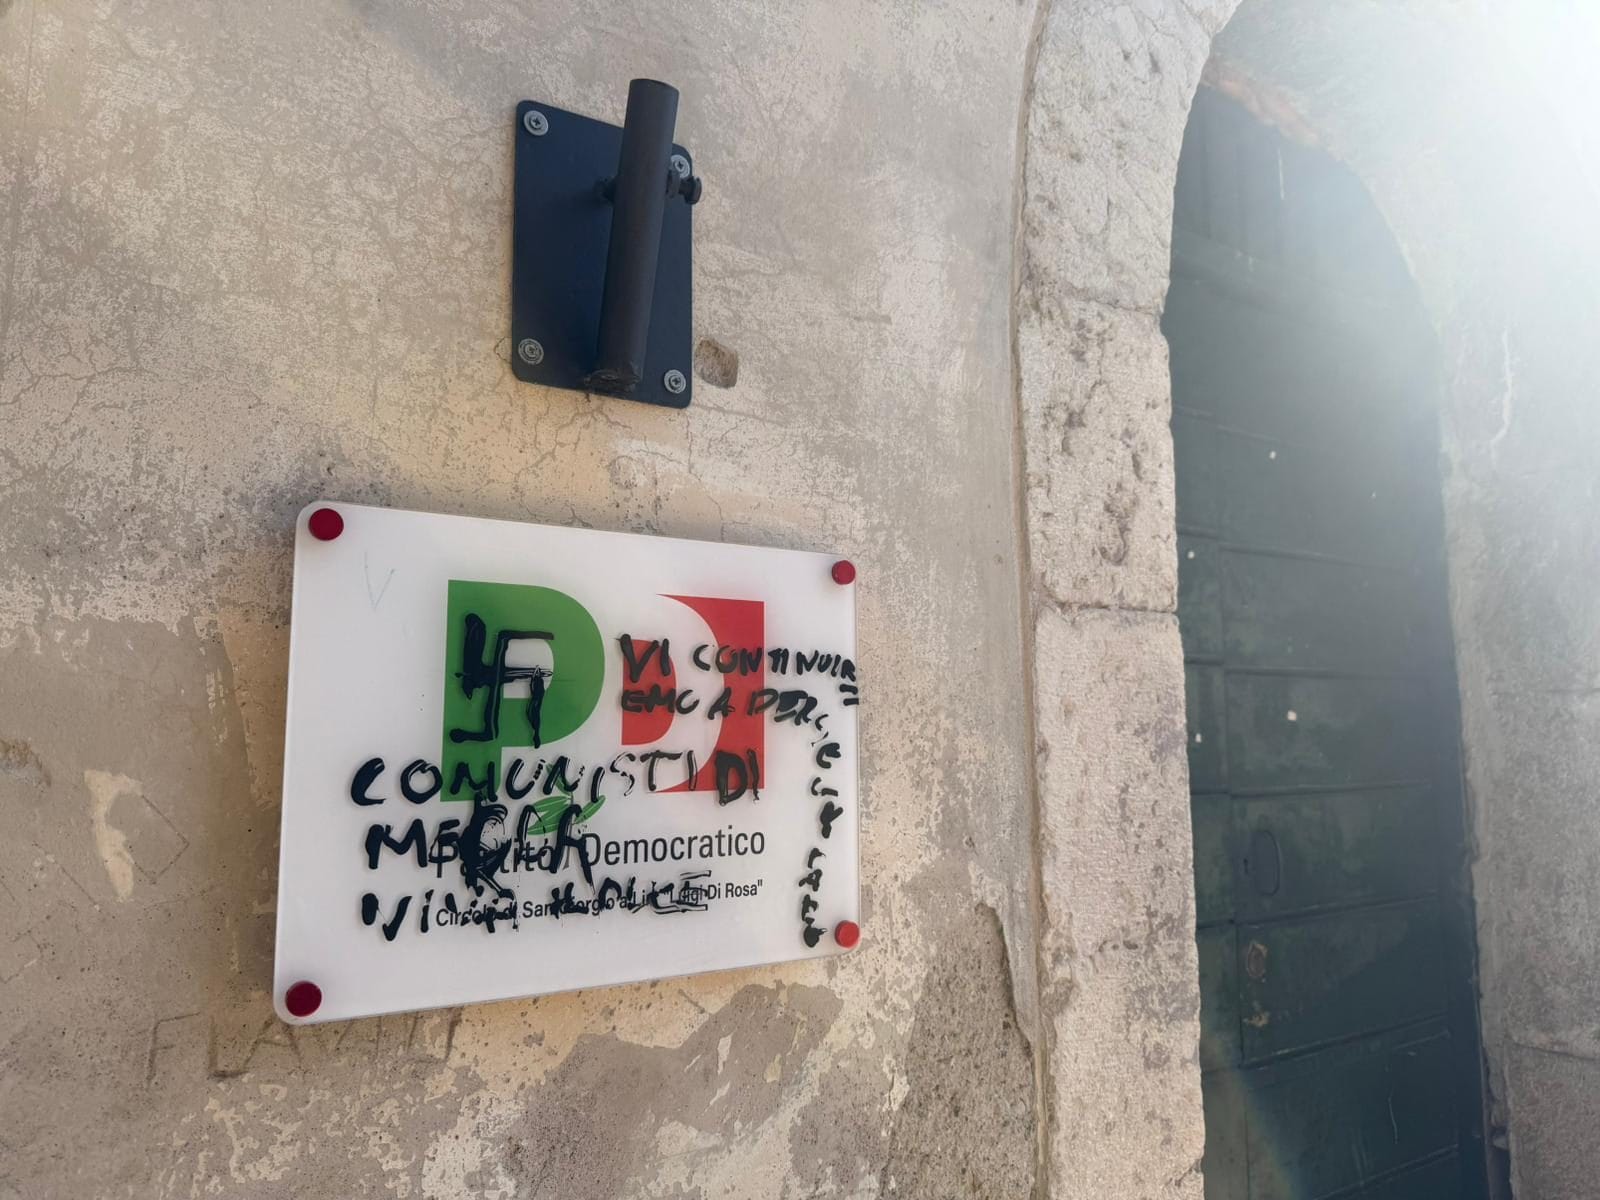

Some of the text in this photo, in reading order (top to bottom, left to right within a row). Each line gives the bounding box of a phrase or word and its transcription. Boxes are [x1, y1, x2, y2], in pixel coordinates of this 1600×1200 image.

[614, 634, 671, 683] VI
[351, 749, 760, 806] COMUNISTI DI
[585, 824, 766, 867] Democratico
[707, 882, 721, 900] Di
[725, 879, 763, 898] Rosa"
